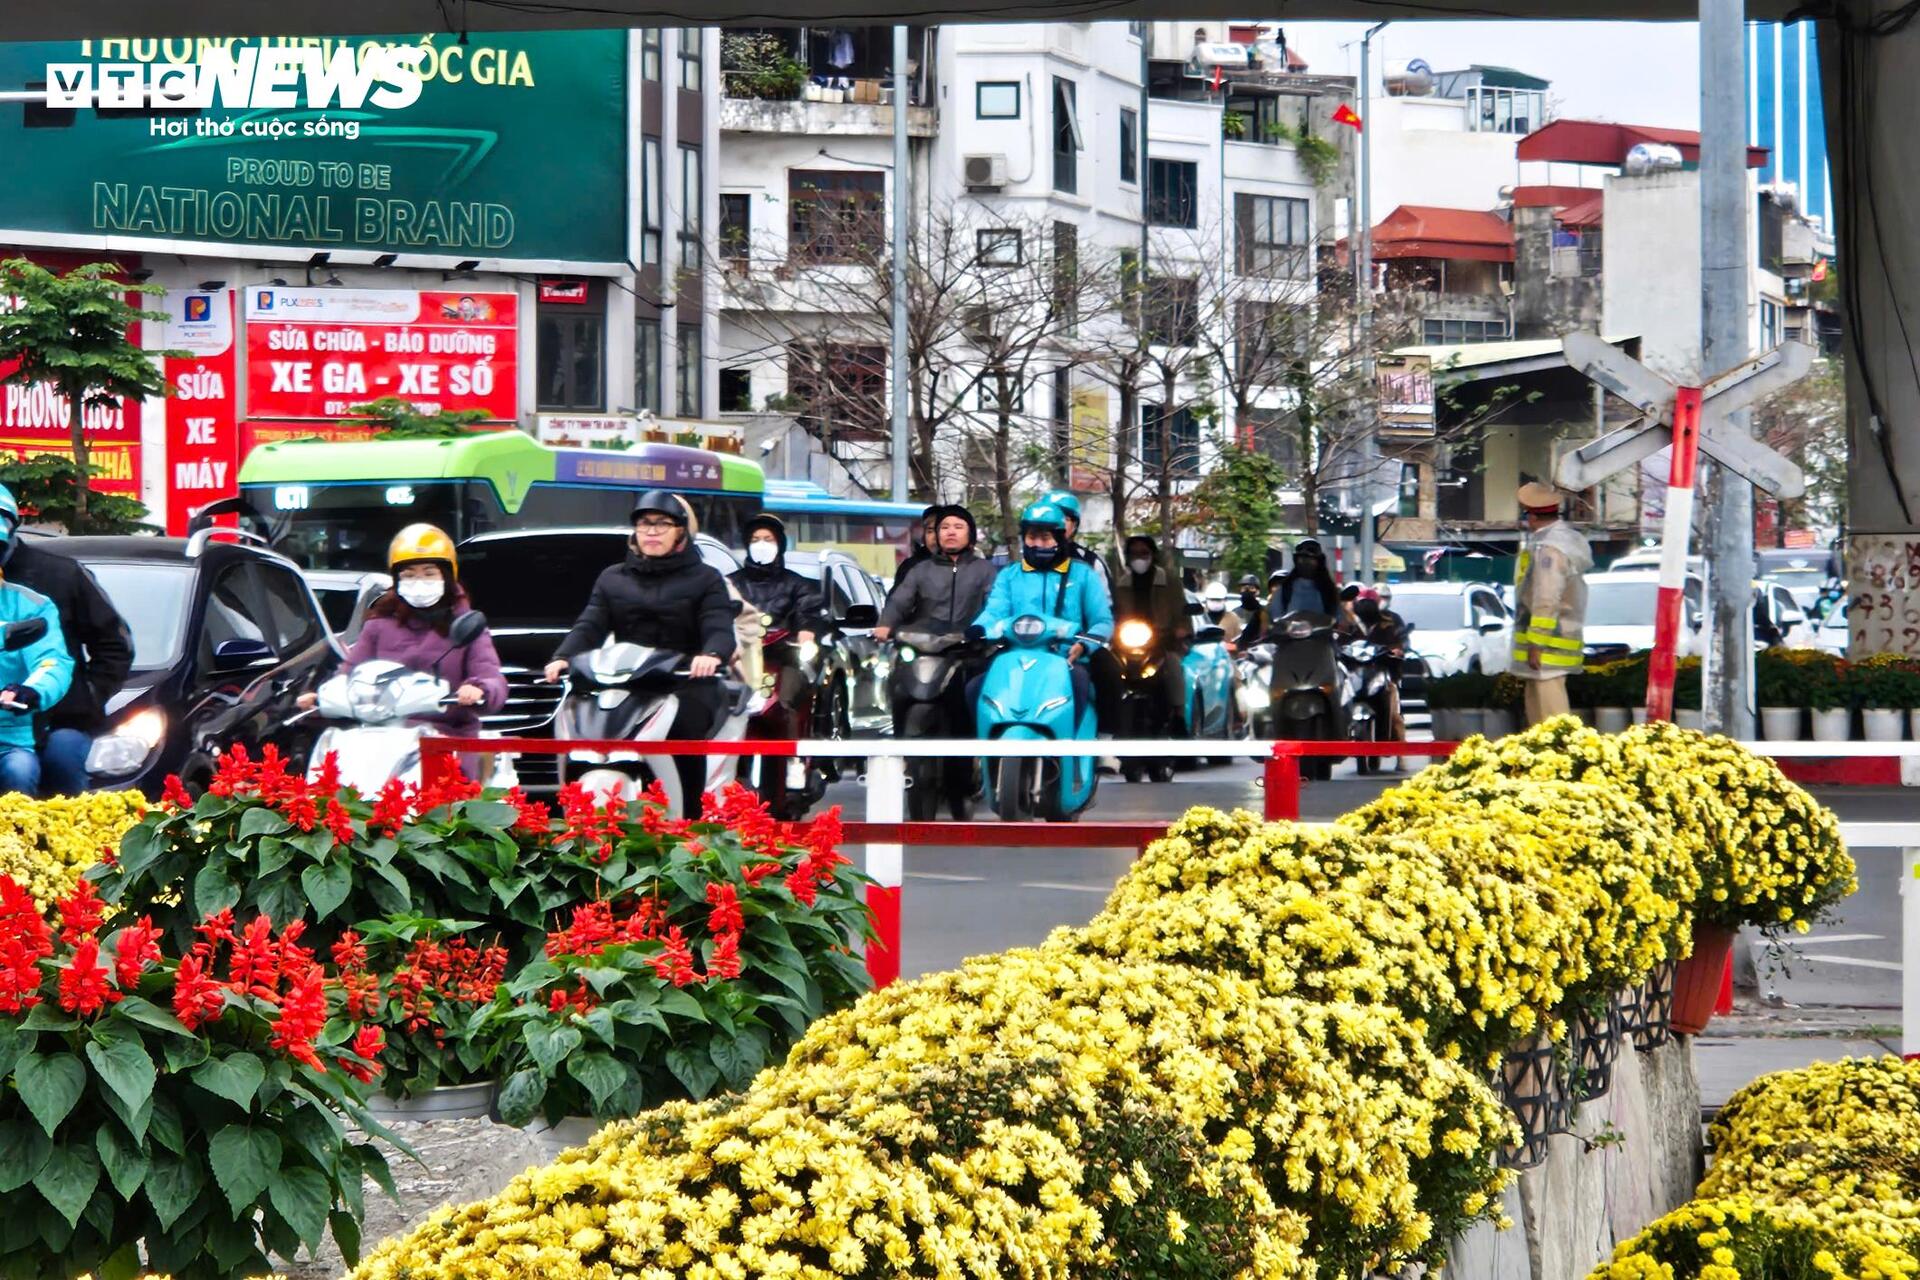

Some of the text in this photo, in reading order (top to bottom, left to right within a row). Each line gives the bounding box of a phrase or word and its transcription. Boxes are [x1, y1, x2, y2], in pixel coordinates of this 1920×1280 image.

[470, 48, 535, 87] GIA
[227, 157, 391, 191] PROUD TO BE
[93, 181, 516, 249] NATIONAL BRAND
[268, 324, 308, 351] SỬA
[313, 328, 367, 352] CHỮA
[384, 327, 424, 354] BẢO
[429, 331, 496, 355] DƯỠNG
[176, 364, 225, 401] SỬA
[270, 361, 313, 393] XE
[322, 362, 368, 394] GA
[398, 364, 440, 395] XE
[449, 356, 494, 396] SỐ
[185, 417, 217, 445] XE
[175, 457, 228, 490] MÁY
